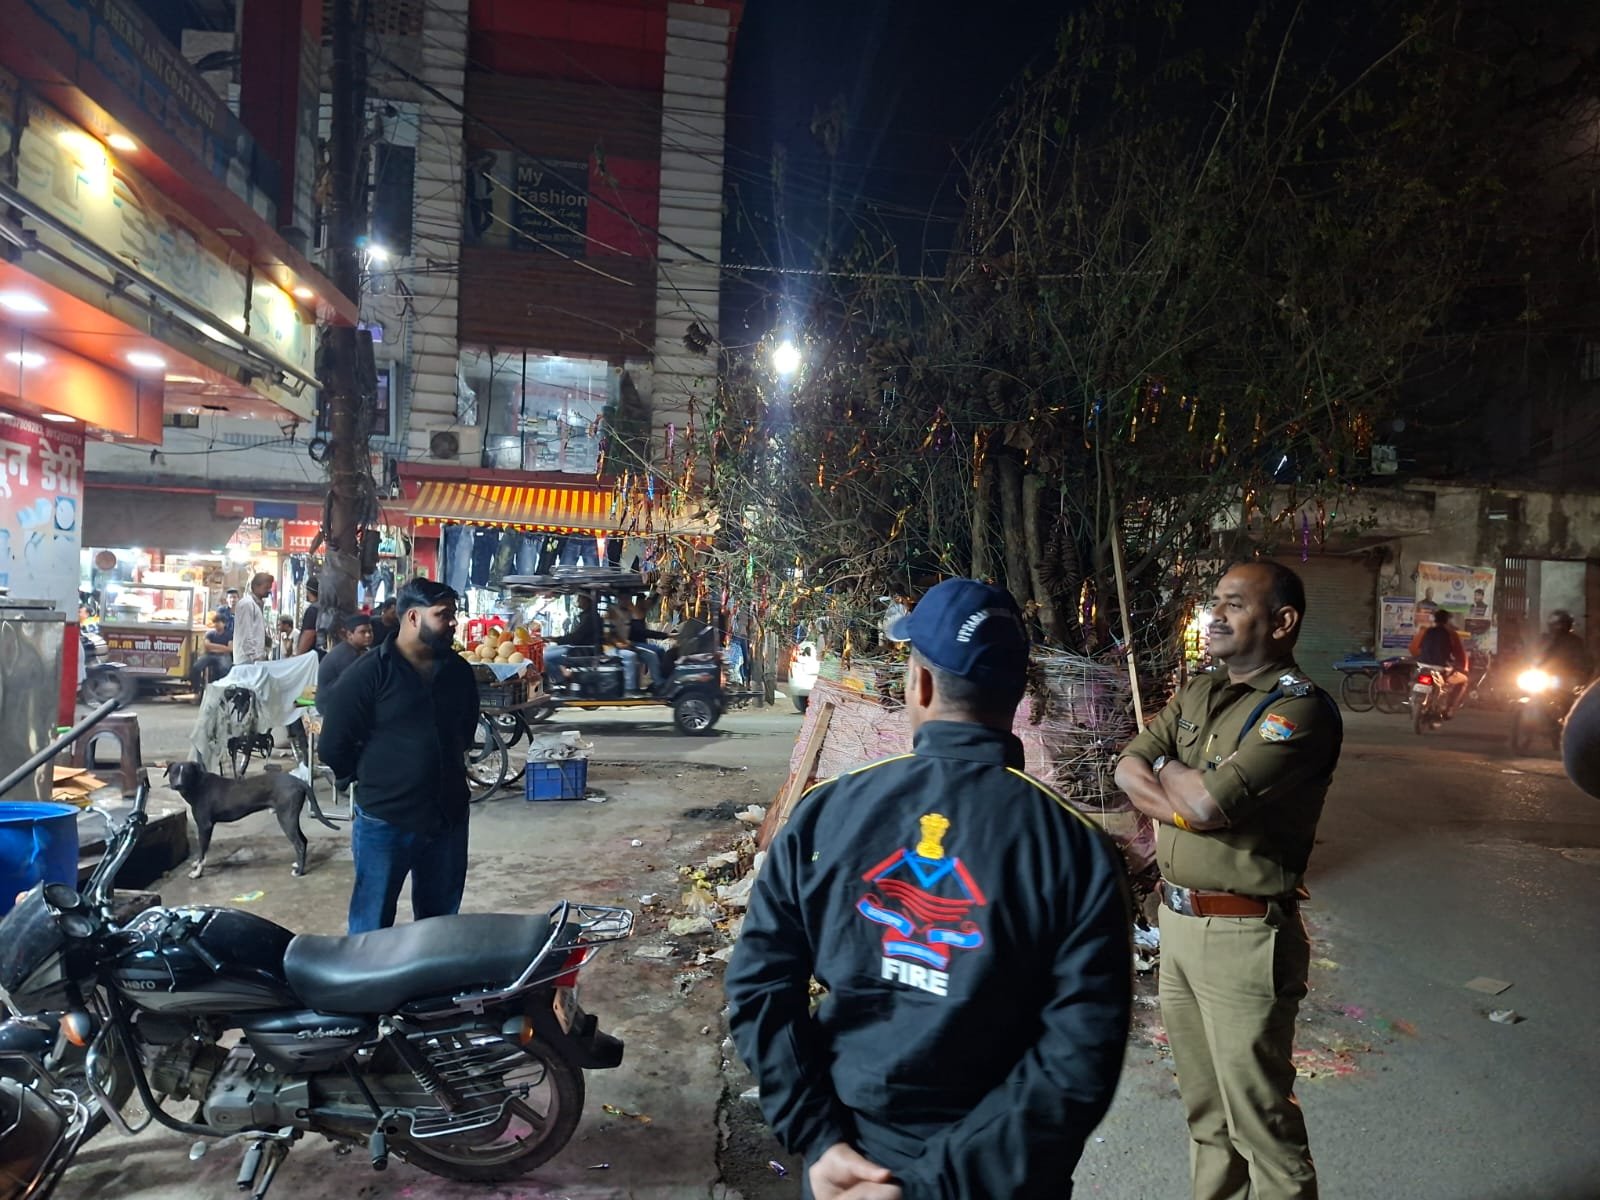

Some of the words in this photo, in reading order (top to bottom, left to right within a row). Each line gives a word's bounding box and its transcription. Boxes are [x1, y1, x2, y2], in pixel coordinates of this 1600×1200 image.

[518, 167, 543, 186] My
[517, 186, 588, 207] Fashion
[881, 956, 950, 997] FIRE
